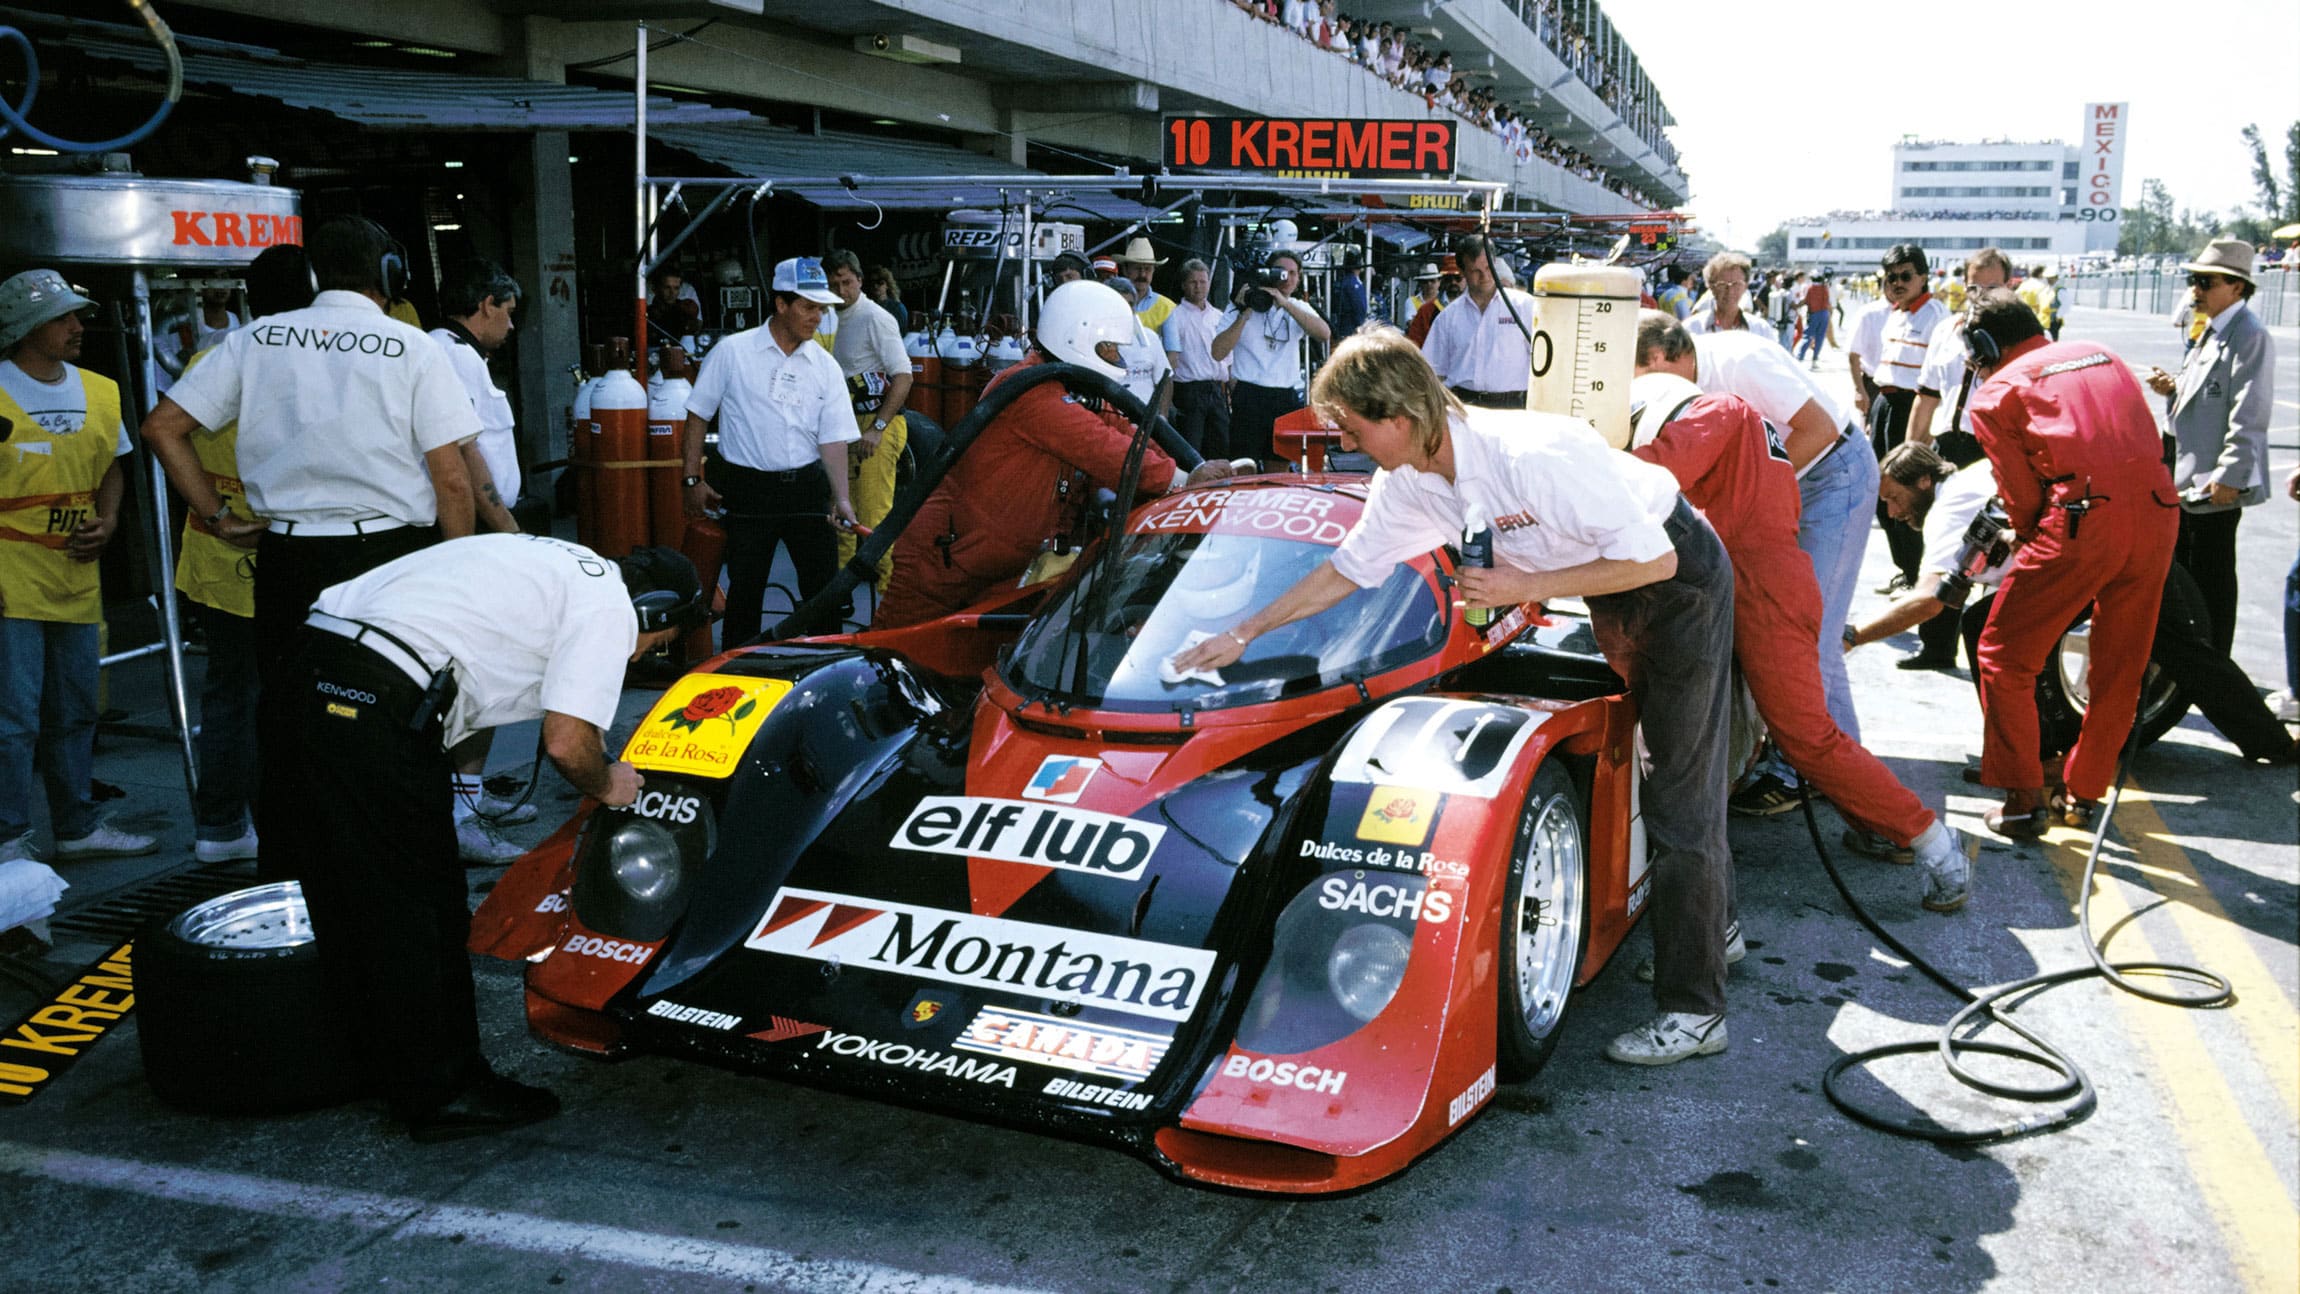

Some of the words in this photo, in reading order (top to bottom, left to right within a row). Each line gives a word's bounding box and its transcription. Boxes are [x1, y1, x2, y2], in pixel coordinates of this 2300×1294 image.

[1170, 119, 1210, 166] 10
[1231, 120, 1450, 170] KREMER
[2089, 104, 2118, 205] MEXICO
[2078, 207, 2117, 222] 90
[1595, 302, 1612, 313] 20
[252, 325, 406, 358] KENWOOD
[1593, 342, 1607, 353] 15
[1590, 381, 1604, 391] 10
[1177, 489, 1336, 518] KREMER
[1135, 508, 1348, 543] KENWOOD
[317, 681, 377, 704] KENWOOD
[633, 741, 658, 756] de
[660, 742, 678, 758] la
[681, 743, 730, 765] Rosa
[607, 789, 700, 824] ACHS
[905, 803, 1025, 852] elf
[1019, 809, 1150, 873] lub
[1300, 839, 1363, 863] Dulces
[1366, 848, 1392, 866] de
[1395, 850, 1414, 869] la
[1417, 852, 1471, 877] Rosa
[1318, 877, 1453, 923] SACHS
[562, 934, 654, 966] BOSCH
[868, 911, 1199, 1010] Montana
[646, 999, 743, 1031] BILSTEIN
[815, 1030, 1019, 1088] YOKOHAMA
[971, 1016, 1152, 1071] CANADA
[1222, 1054, 1348, 1095] BOSCH
[1043, 1077, 1154, 1111] BILSTEIN
[1448, 1062, 1496, 1127] BILSTEIN
